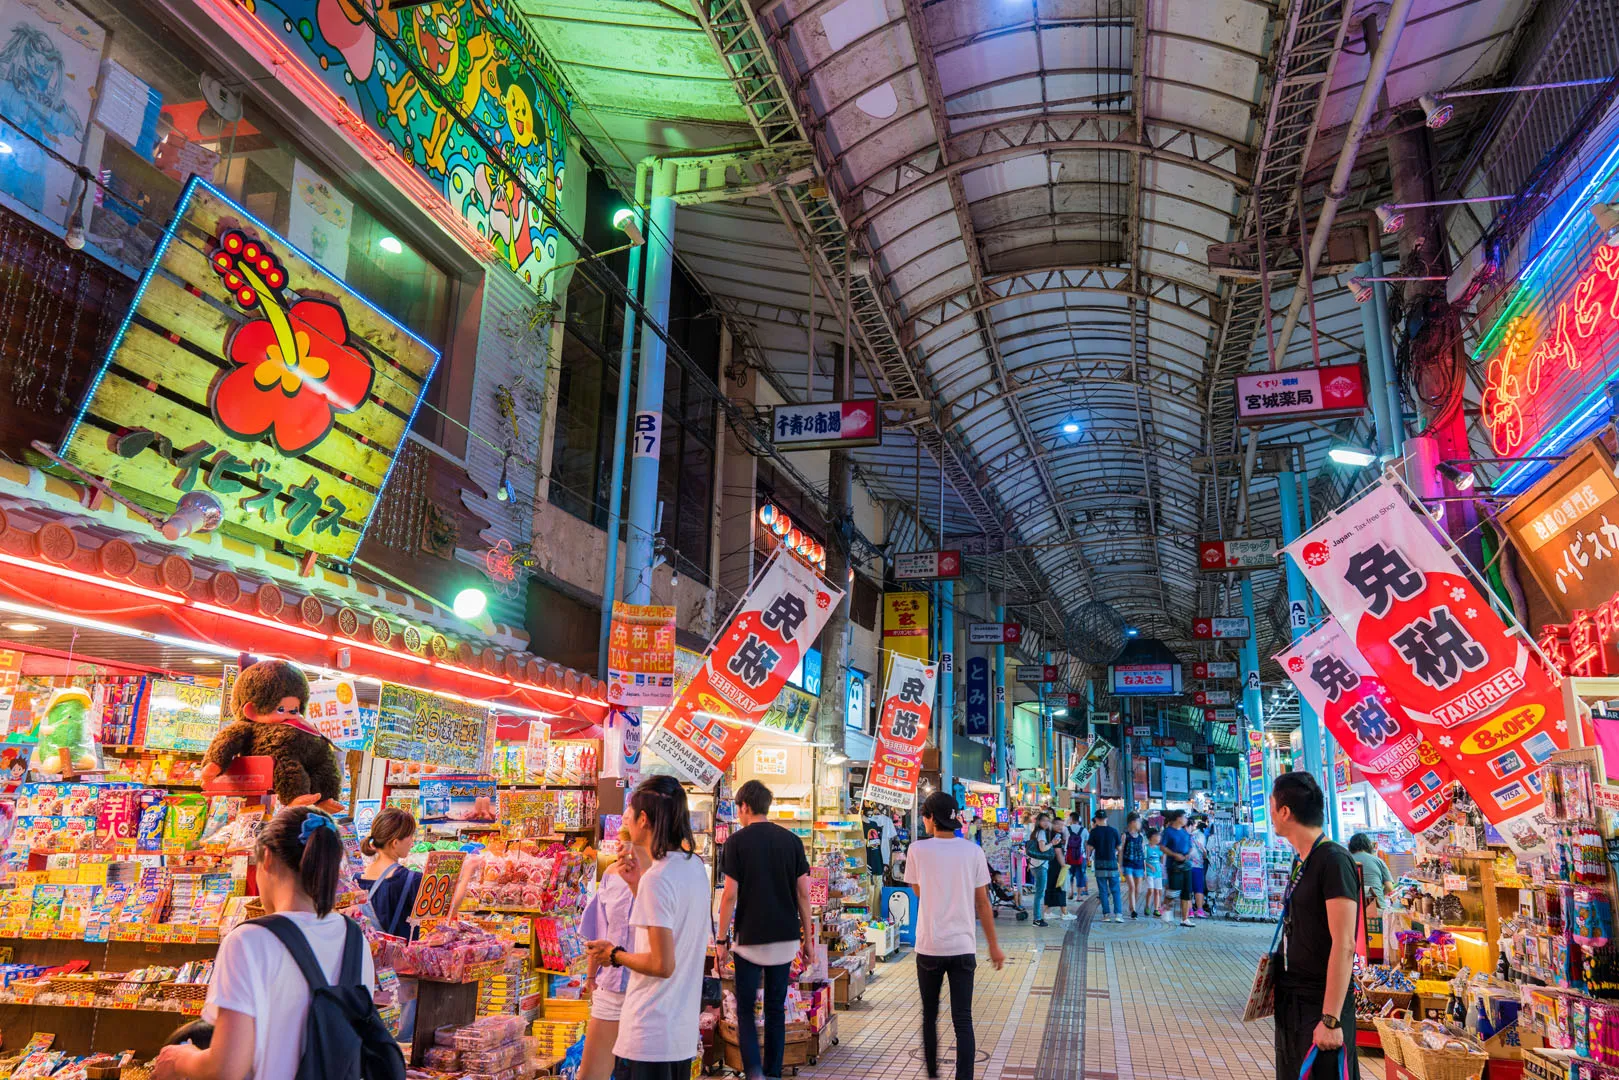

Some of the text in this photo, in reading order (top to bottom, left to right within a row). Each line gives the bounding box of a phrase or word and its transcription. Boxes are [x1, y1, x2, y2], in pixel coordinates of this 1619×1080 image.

[1245, 390, 1314, 410] 宮城薬局
[635, 414, 656, 432] B
[634, 435, 656, 453] 17
[114, 427, 346, 537] ハイビスカス
[1353, 514, 1380, 533] Tax-free
[1379, 501, 1397, 519] Shop
[1230, 540, 1270, 552] ドラッグ
[1241, 552, 1276, 565] セガミ
[1291, 603, 1305, 614] A
[1343, 542, 1486, 690] 免税
[1291, 614, 1306, 625] 15
[614, 624, 671, 651] 免税店
[942, 654, 952, 662] B
[942, 663, 952, 672] 15
[1124, 675, 1164, 685] なみさと
[1249, 680, 1259, 689] 14
[969, 664, 986, 730] とみや
[1310, 654, 1400, 749] 免税
[1434, 671, 1523, 727] TAX FREE
[1472, 708, 1537, 750] 8%OFF
[1370, 735, 1418, 771] TAX FREE
[1389, 753, 1420, 780] SHOP
[450, 785, 495, 797] ちんすこう
[1502, 789, 1521, 801] VISA
[1412, 807, 1428, 820] VISA
[416, 874, 451, 917] 88
